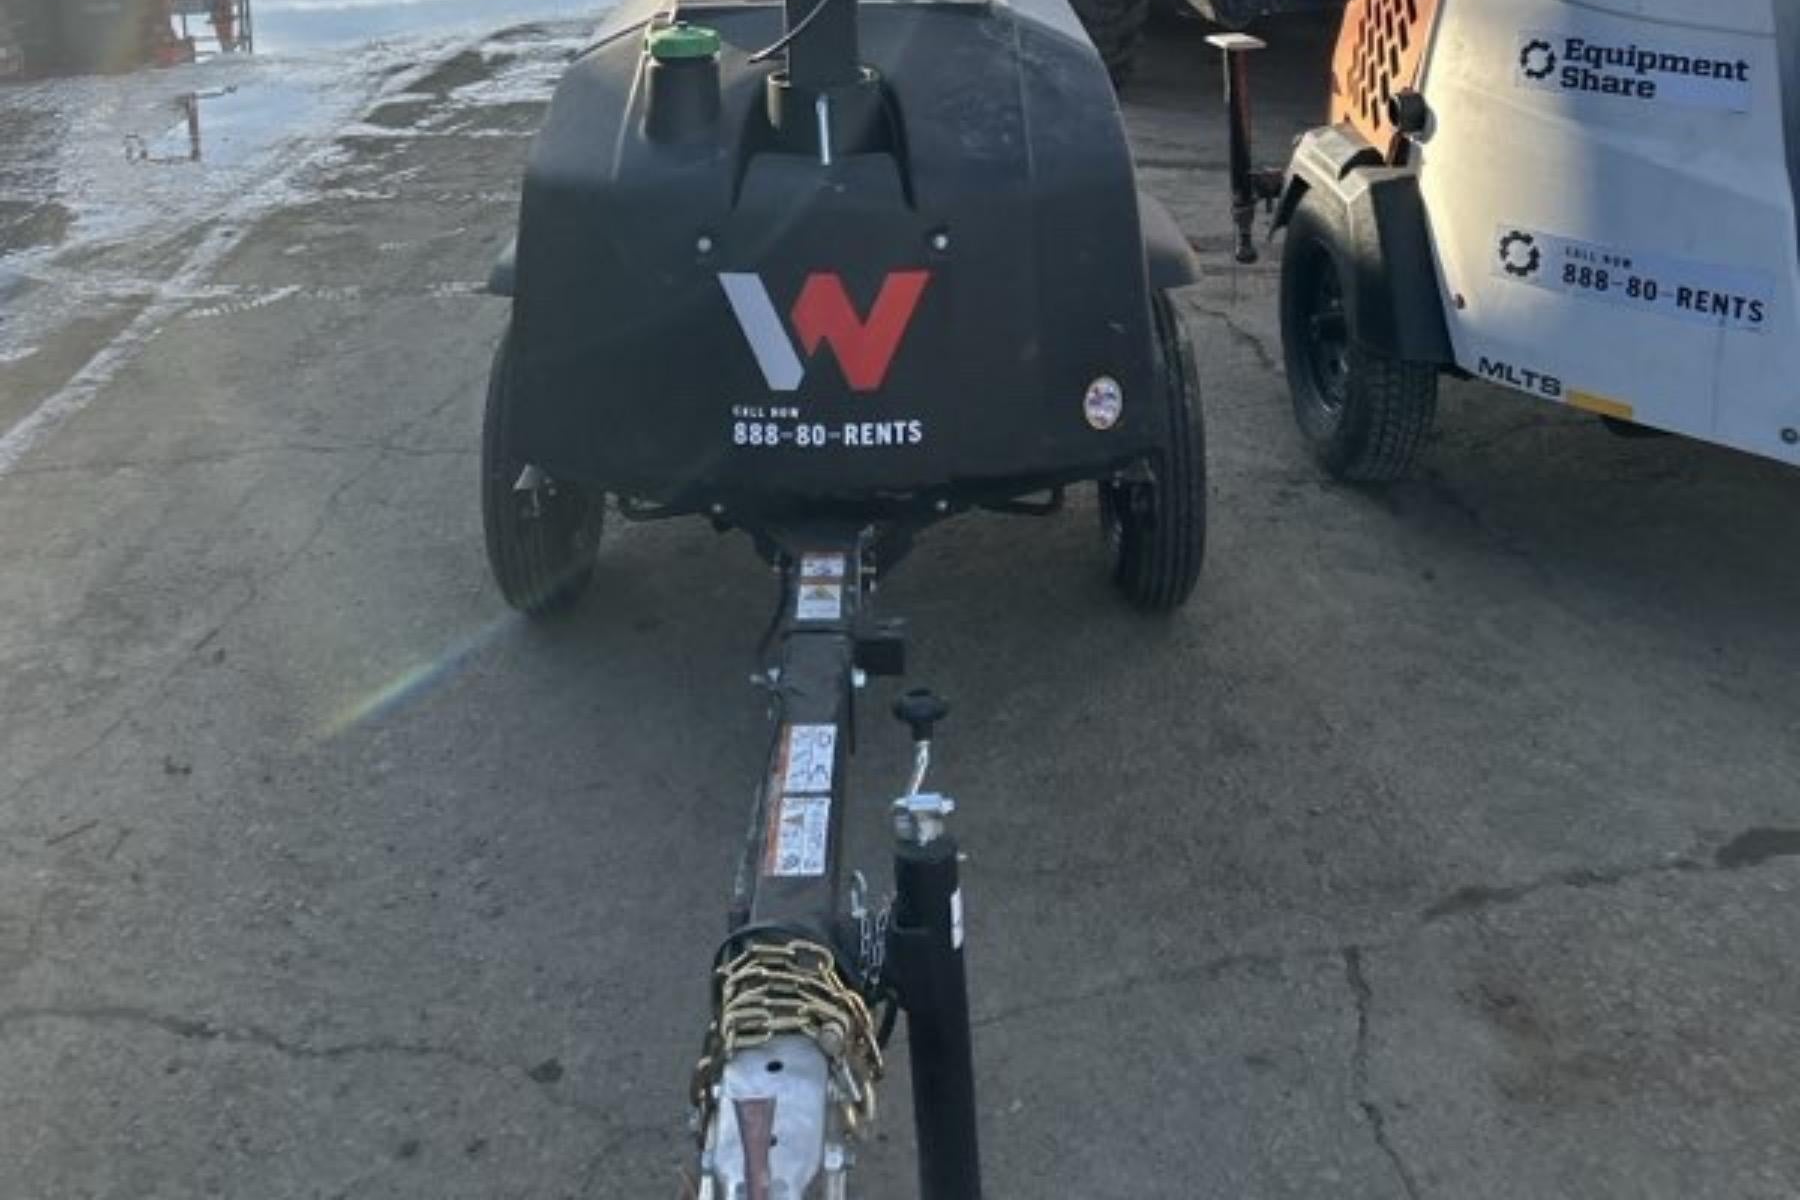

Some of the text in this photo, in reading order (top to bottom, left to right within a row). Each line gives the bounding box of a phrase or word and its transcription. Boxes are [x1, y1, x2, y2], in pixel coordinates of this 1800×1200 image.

[1563, 38, 1750, 81] Equipment
[1560, 65, 1656, 99] Share
[1563, 263, 1764, 323] 888-80-RENTS
[1478, 356, 1561, 397] MLTS
[733, 420, 923, 446] 888-80-RENTS
